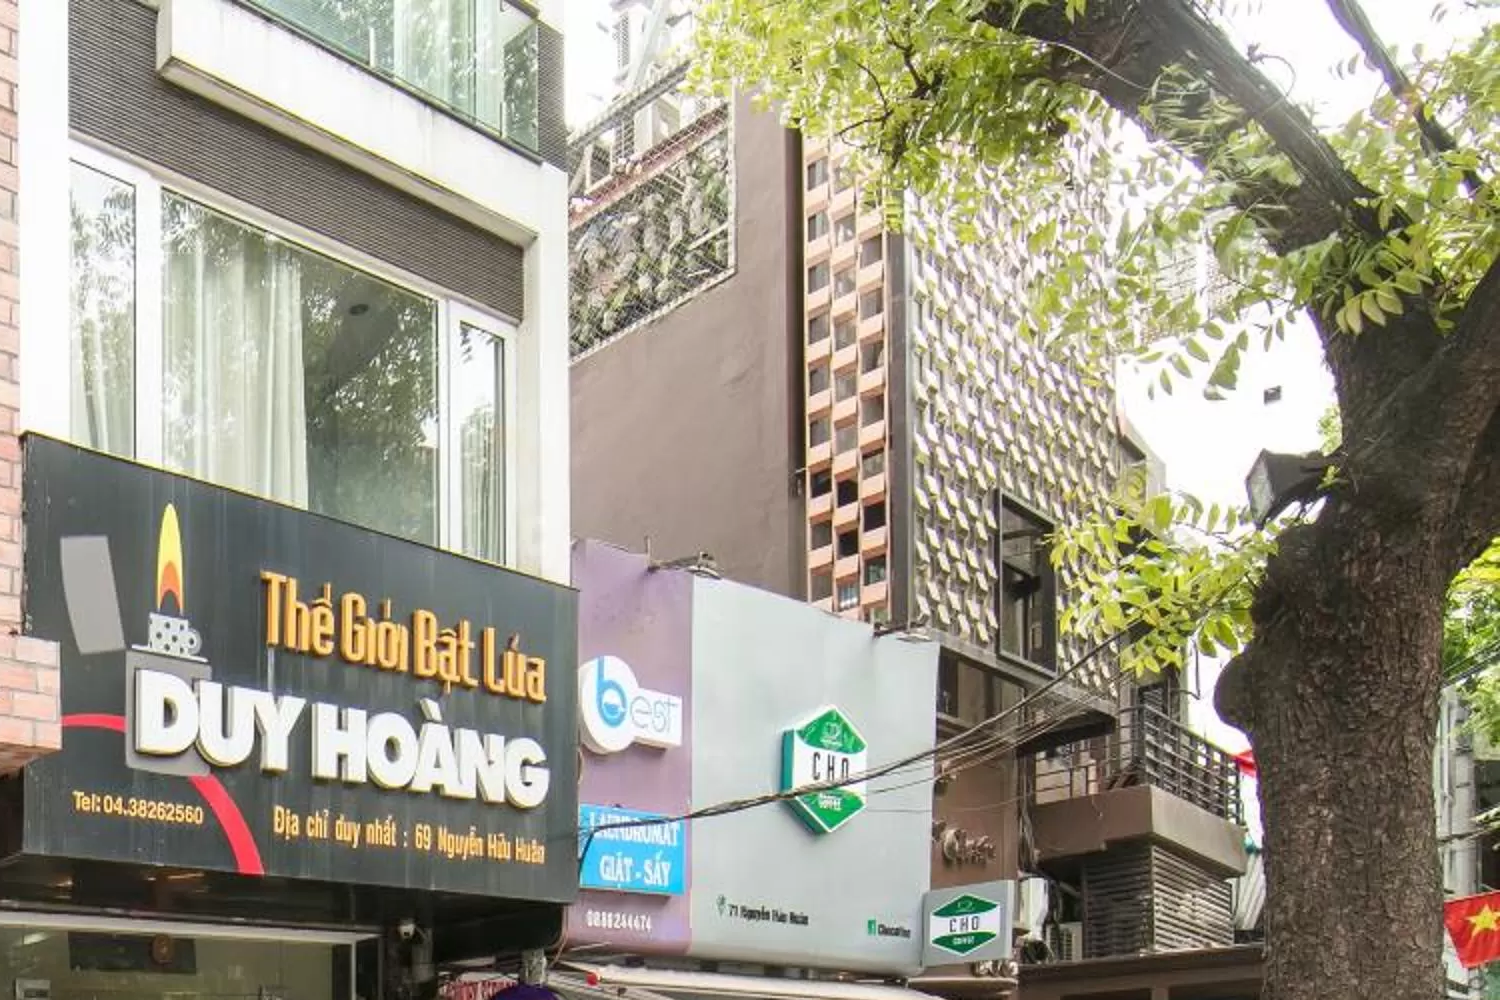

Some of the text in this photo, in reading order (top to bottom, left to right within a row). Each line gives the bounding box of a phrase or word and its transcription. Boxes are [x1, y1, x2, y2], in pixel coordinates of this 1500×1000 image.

[413, 608, 478, 695] Bật
[135, 668, 550, 811] DUY HOÀNG
[811, 751, 849, 782] CHO
[273, 804, 300, 840] Địa
[305, 809, 330, 839] chỉ
[365, 814, 397, 847] nhất
[415, 823, 431, 850] 69
[437, 825, 484, 860] Nguyễn
[949, 916, 980, 933] CHO
